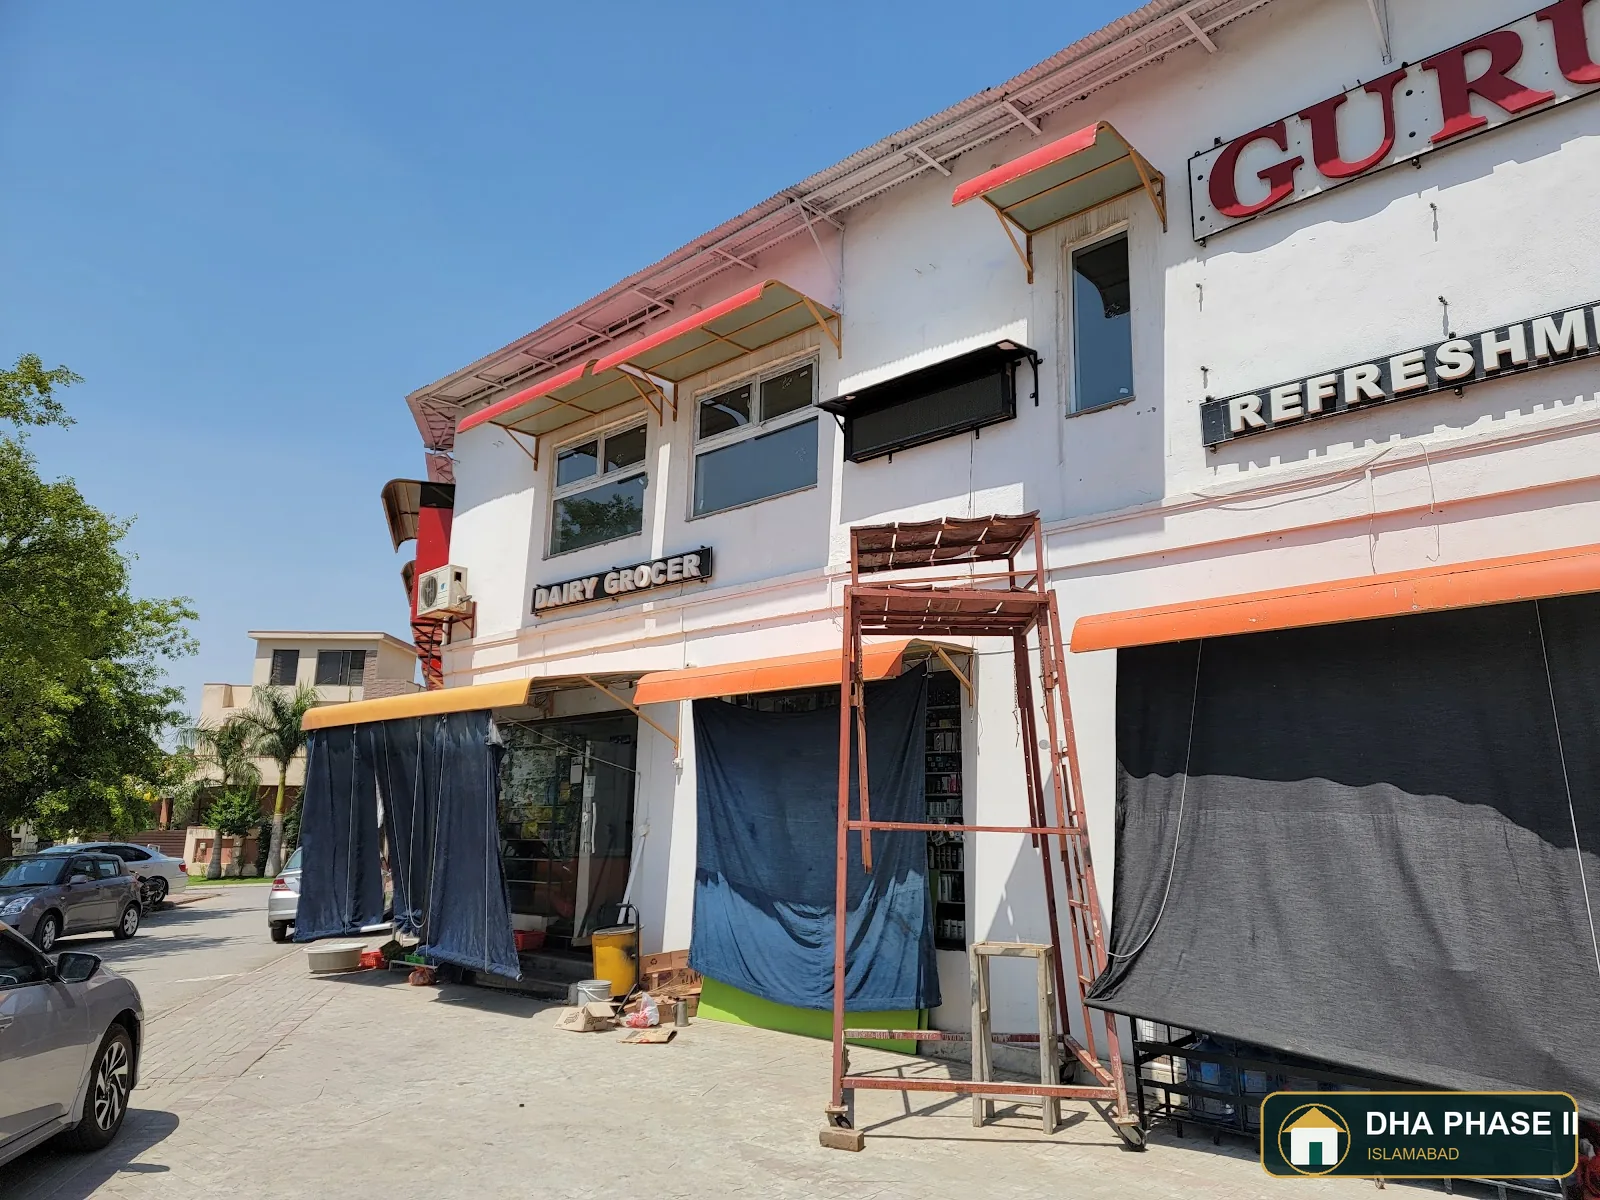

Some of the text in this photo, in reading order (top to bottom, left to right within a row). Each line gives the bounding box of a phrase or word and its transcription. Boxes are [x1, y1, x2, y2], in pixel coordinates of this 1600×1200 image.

[1229, 305, 1600, 433] REFRESHM
[535, 553, 700, 610] DAIRY GROCER
